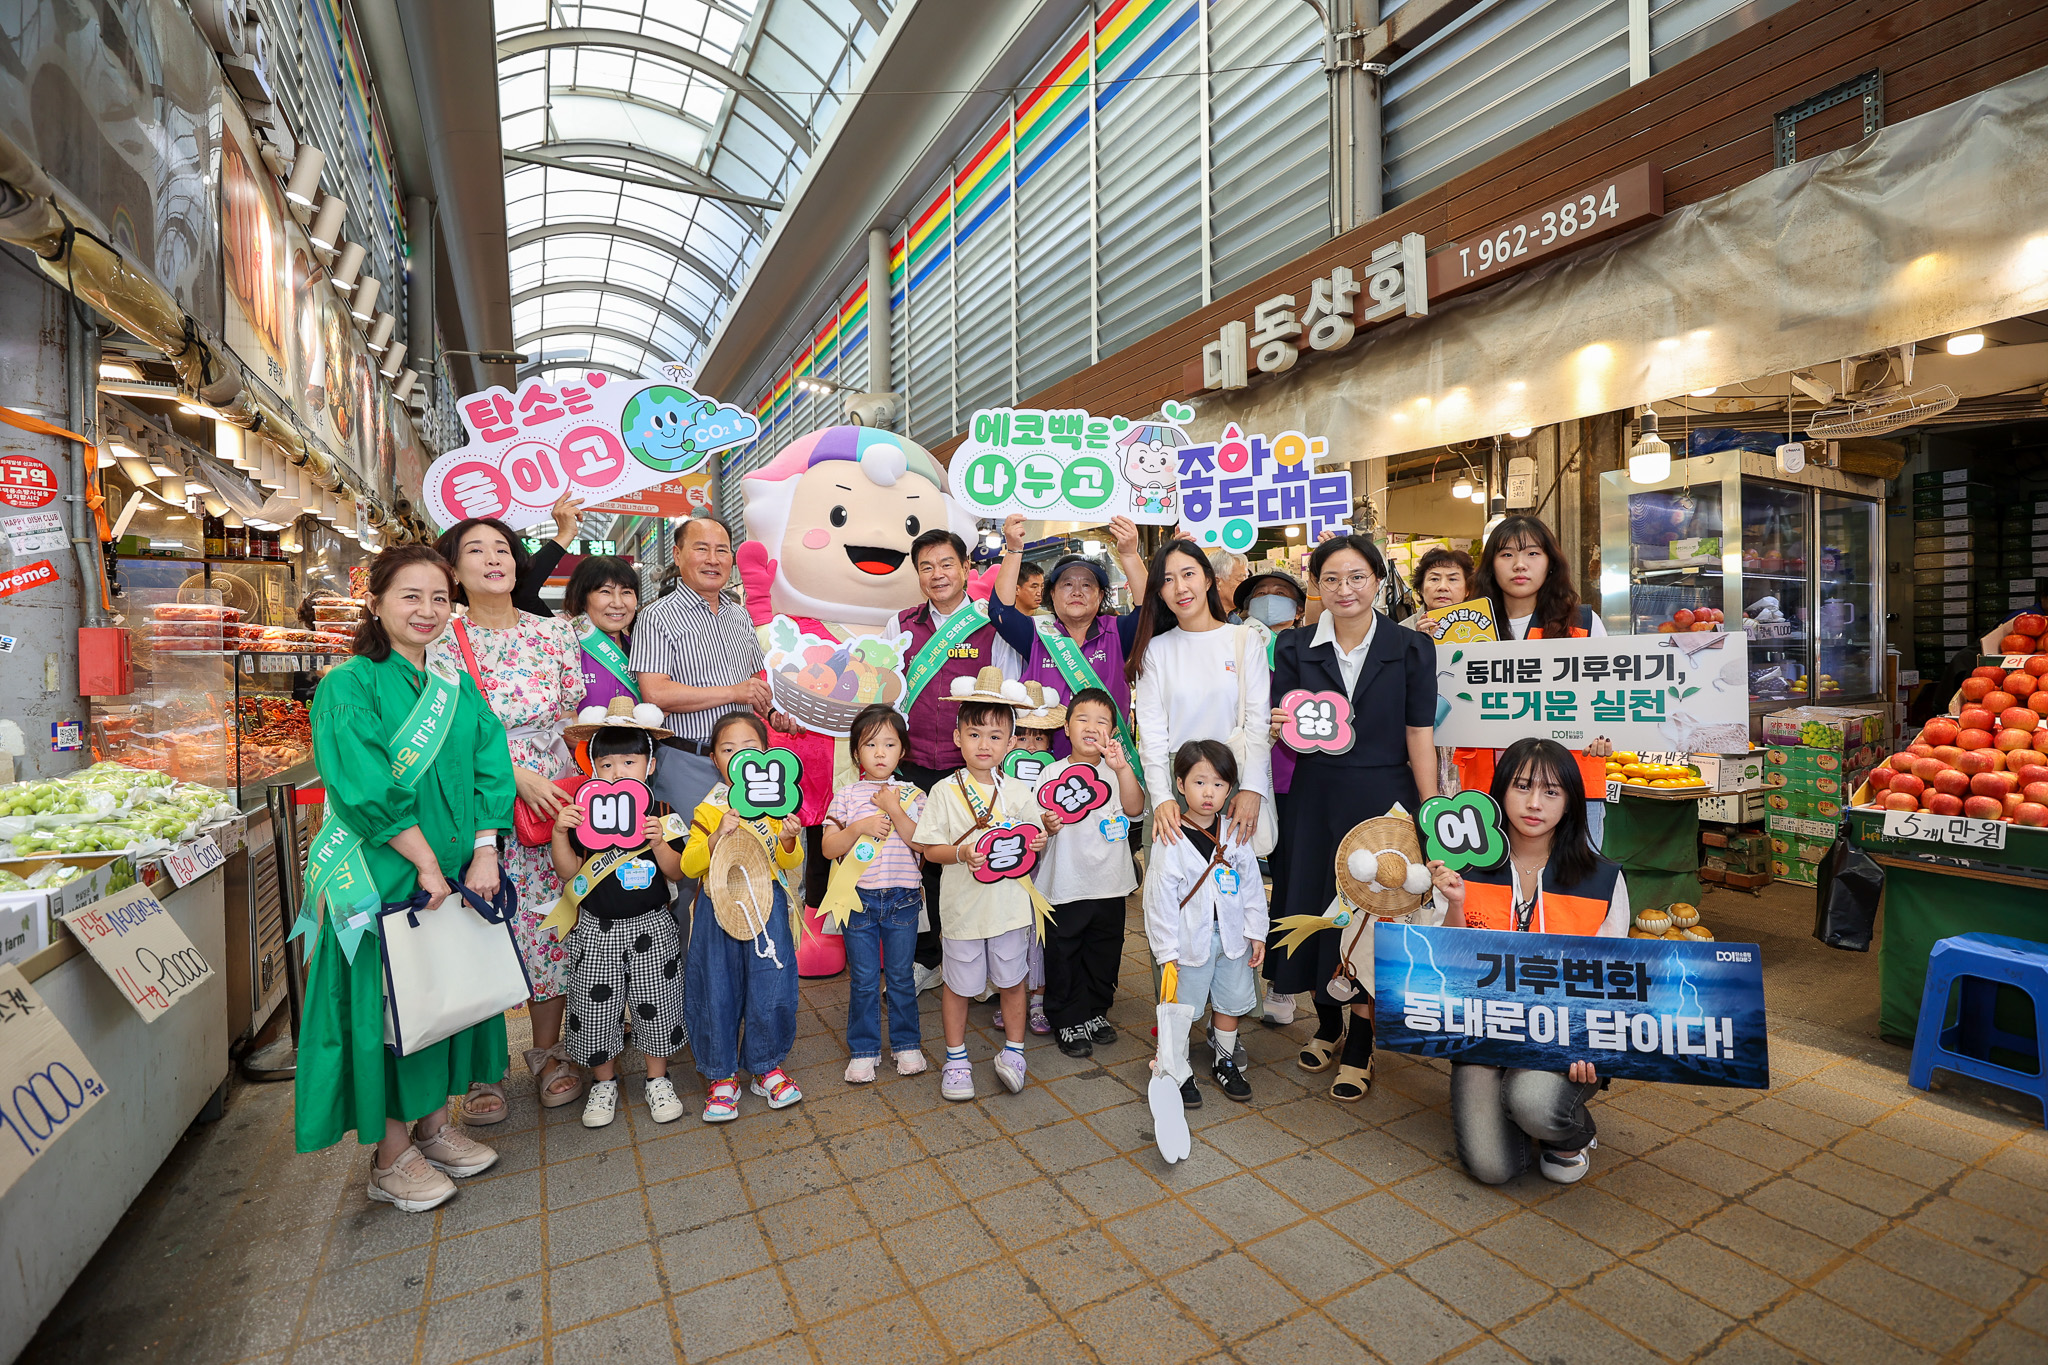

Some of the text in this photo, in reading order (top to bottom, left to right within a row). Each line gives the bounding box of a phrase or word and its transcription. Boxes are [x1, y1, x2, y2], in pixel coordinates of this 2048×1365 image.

[1203, 184, 1620, 390] 대동상회 T.962-3834
[465, 384, 594, 443] 탄소는
[975, 412, 1109, 451] 에코백은
[0, 466, 47, 487] 구역
[452, 434, 617, 518] 줄이고
[973, 464, 1104, 501] 나누고
[1178, 426, 1310, 522] 좋아요
[689, 488, 705, 503] 축
[1219, 476, 1347, 549] 동대문
[4, 513, 59, 527] HAPPY DISH CLUB
[947, 648, 979, 658] 이필형
[1466, 654, 1686, 685] 동대문 기후위기,
[1481, 690, 1667, 722] 뜨거운 실천
[411, 717, 437, 749] 쓰는
[745, 763, 780, 801] 닐
[592, 795, 630, 832] 비
[1438, 808, 1481, 849] 어
[1895, 814, 1943, 842] 5개
[1948, 819, 2001, 849] 만원
[989, 835, 1023, 869] 봉
[5, 933, 25, 953] farm
[116, 966, 169, 1010] 4kg
[1476, 953, 1652, 1001] 기후변화
[1403, 991, 1734, 1059] 동대문이 답이다!
